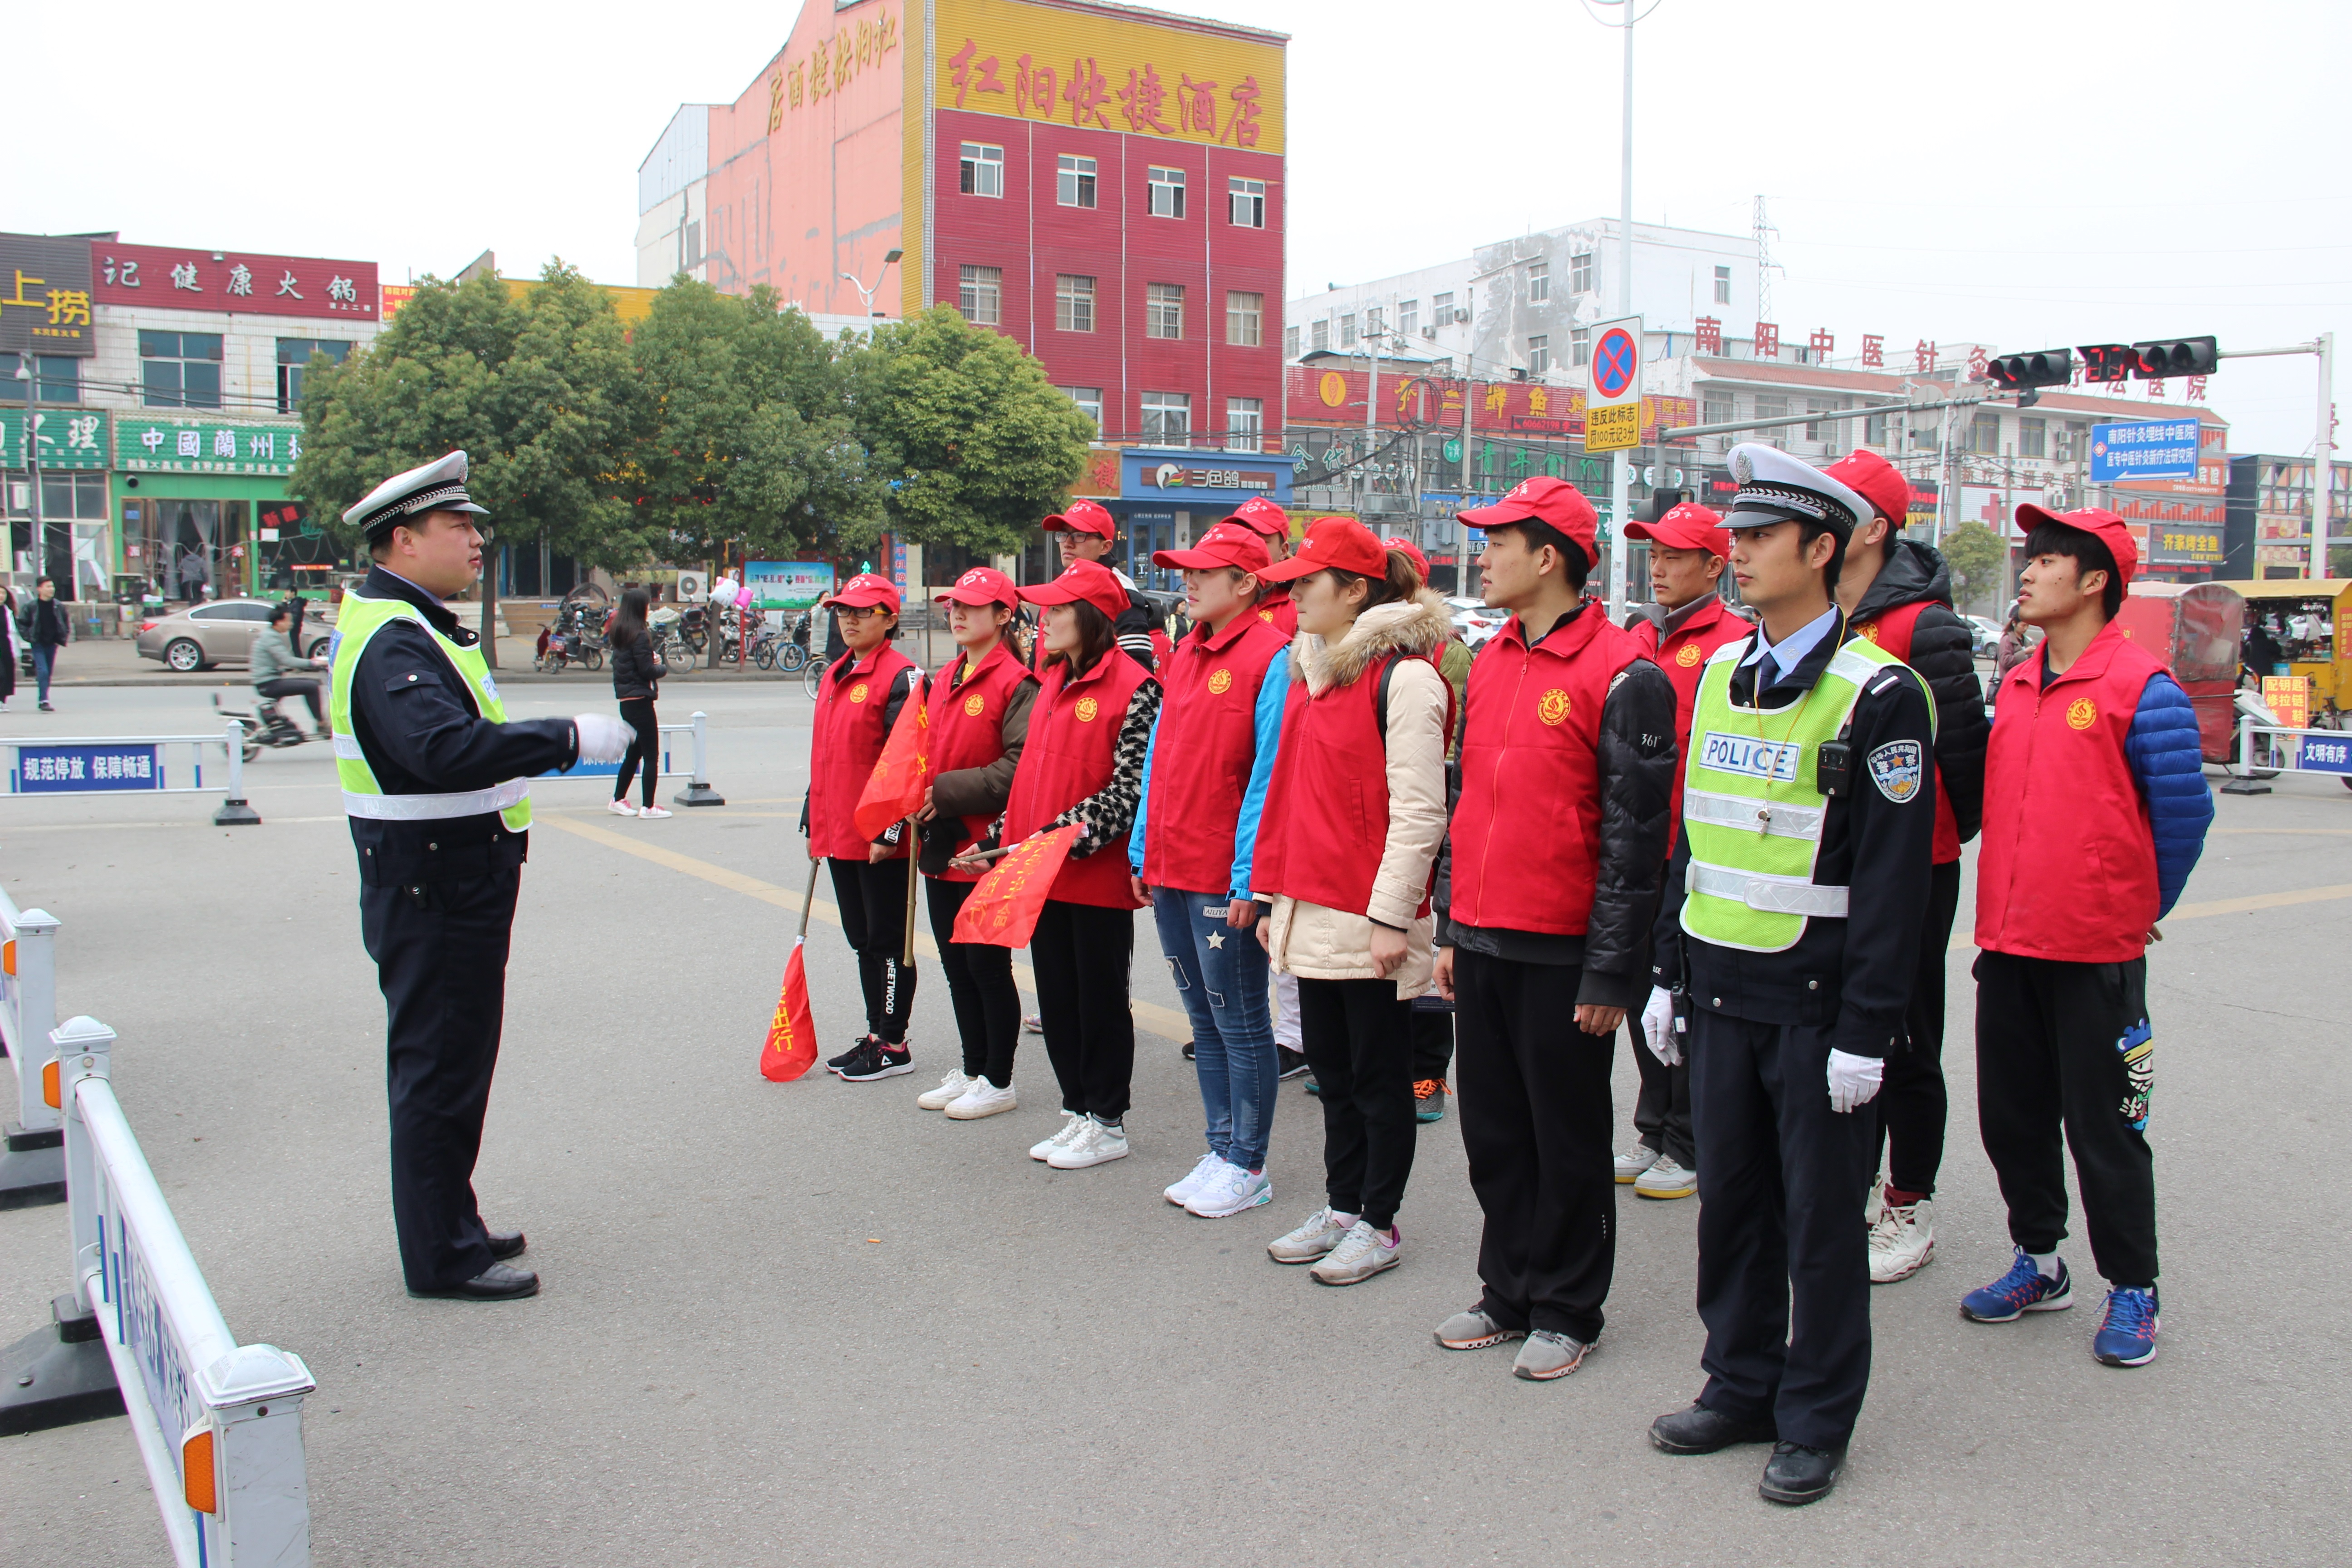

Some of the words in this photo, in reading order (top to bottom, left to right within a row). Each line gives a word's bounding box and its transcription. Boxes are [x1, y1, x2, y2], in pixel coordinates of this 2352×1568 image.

[949, 38, 1262, 147] 红阳快捷酒店
[103, 256, 357, 303] 记健康火锅
[1695, 315, 1990, 381] 南阳中医针灸
[1523, 419, 1560, 429] 60662198
[1591, 406, 1635, 426] 违反此标志
[1590, 425, 1635, 446] 罚100元记3分
[2107, 424, 2195, 445] 南阳针灸埋线中医院
[2107, 447, 2194, 467] 医专中医针灸新疗法研究所
[1192, 469, 1239, 489] 三色鸽
[2162, 533, 2219, 552] 齐家烤全鱼
[895, 546, 906, 597] 手机换屏
[2266, 679, 2303, 691] 配钥匙
[2266, 694, 2303, 707] 修拉链
[2292, 709, 2304, 722] 鞋
[1642, 733, 1661, 748] 361°
[1708, 739, 1788, 772] POLICE
[1871, 745, 1917, 764] 中华人民共和国
[2305, 743, 2347, 764] 文明有序
[24, 757, 85, 781] 规范停放
[93, 755, 152, 779] 保障畅通
[1876, 760, 1889, 774] 警
[1905, 755, 1916, 767] 察
[886, 957, 896, 1014] SWEETWOOD
